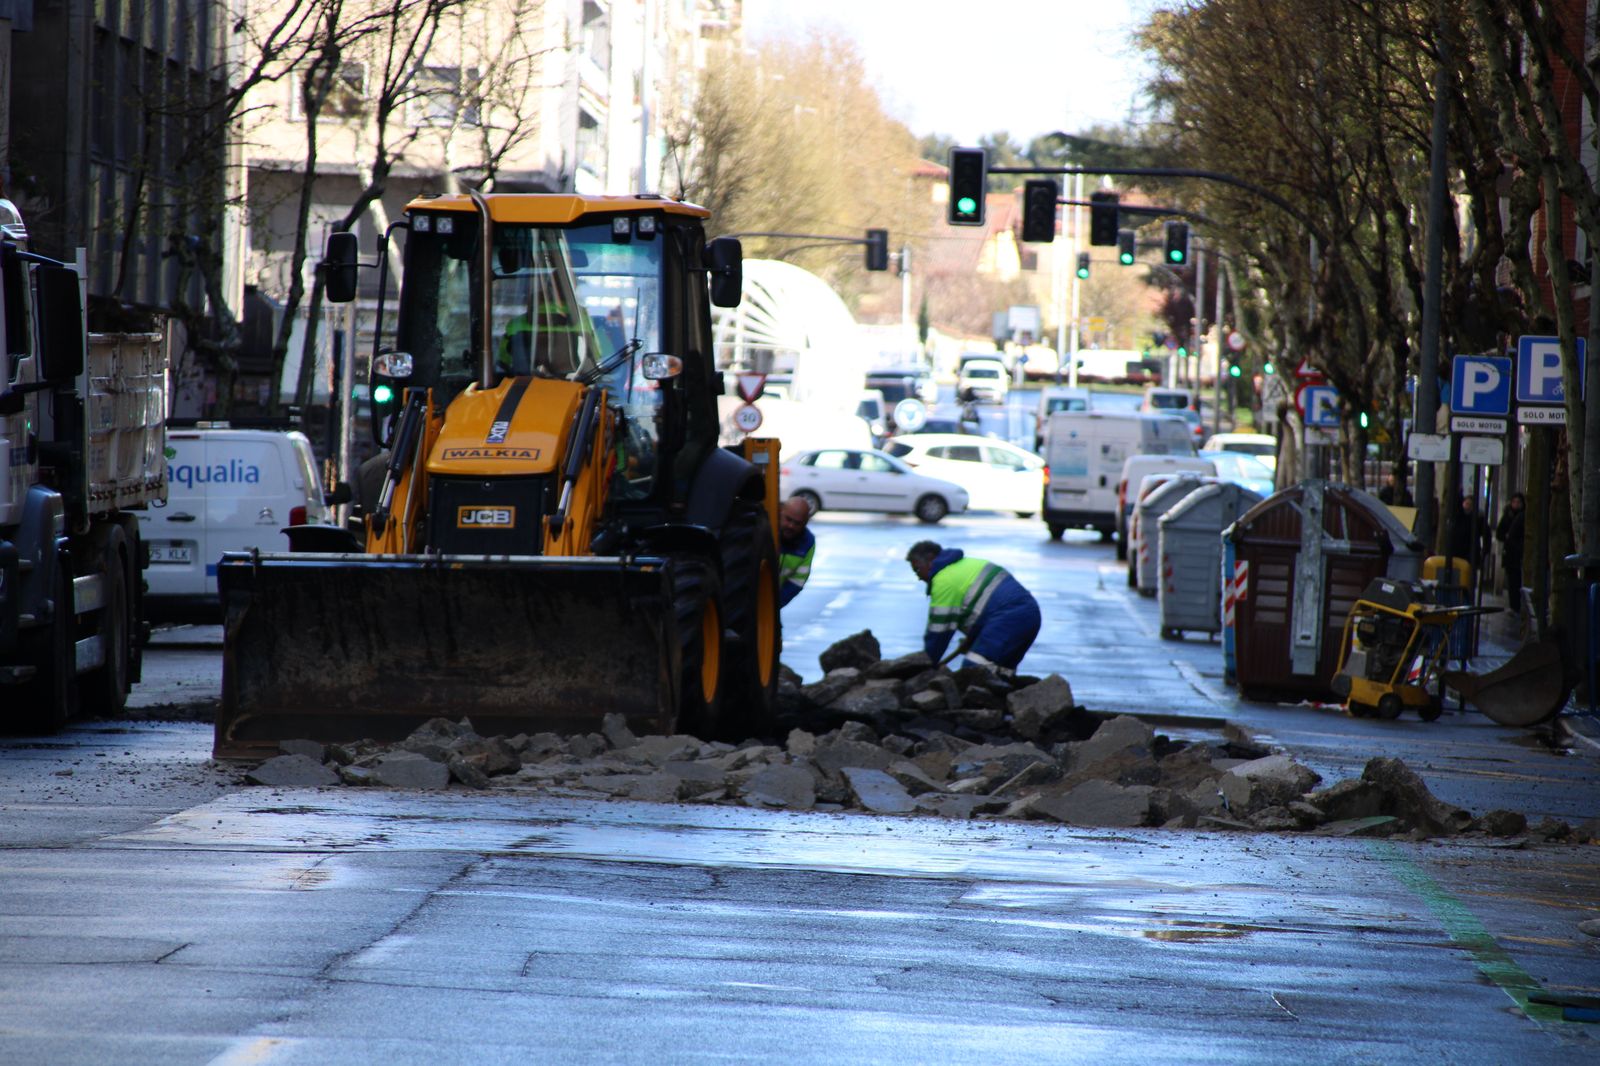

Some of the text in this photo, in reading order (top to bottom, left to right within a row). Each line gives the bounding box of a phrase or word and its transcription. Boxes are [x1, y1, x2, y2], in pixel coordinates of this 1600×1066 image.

[1530, 342, 1562, 395] P
[1462, 361, 1500, 408] P
[1523, 411, 1564, 420] SOLO MOT
[1456, 421, 1475, 429] SOLO
[450, 449, 532, 458] WALKIA
[462, 510, 510, 524] JCB
